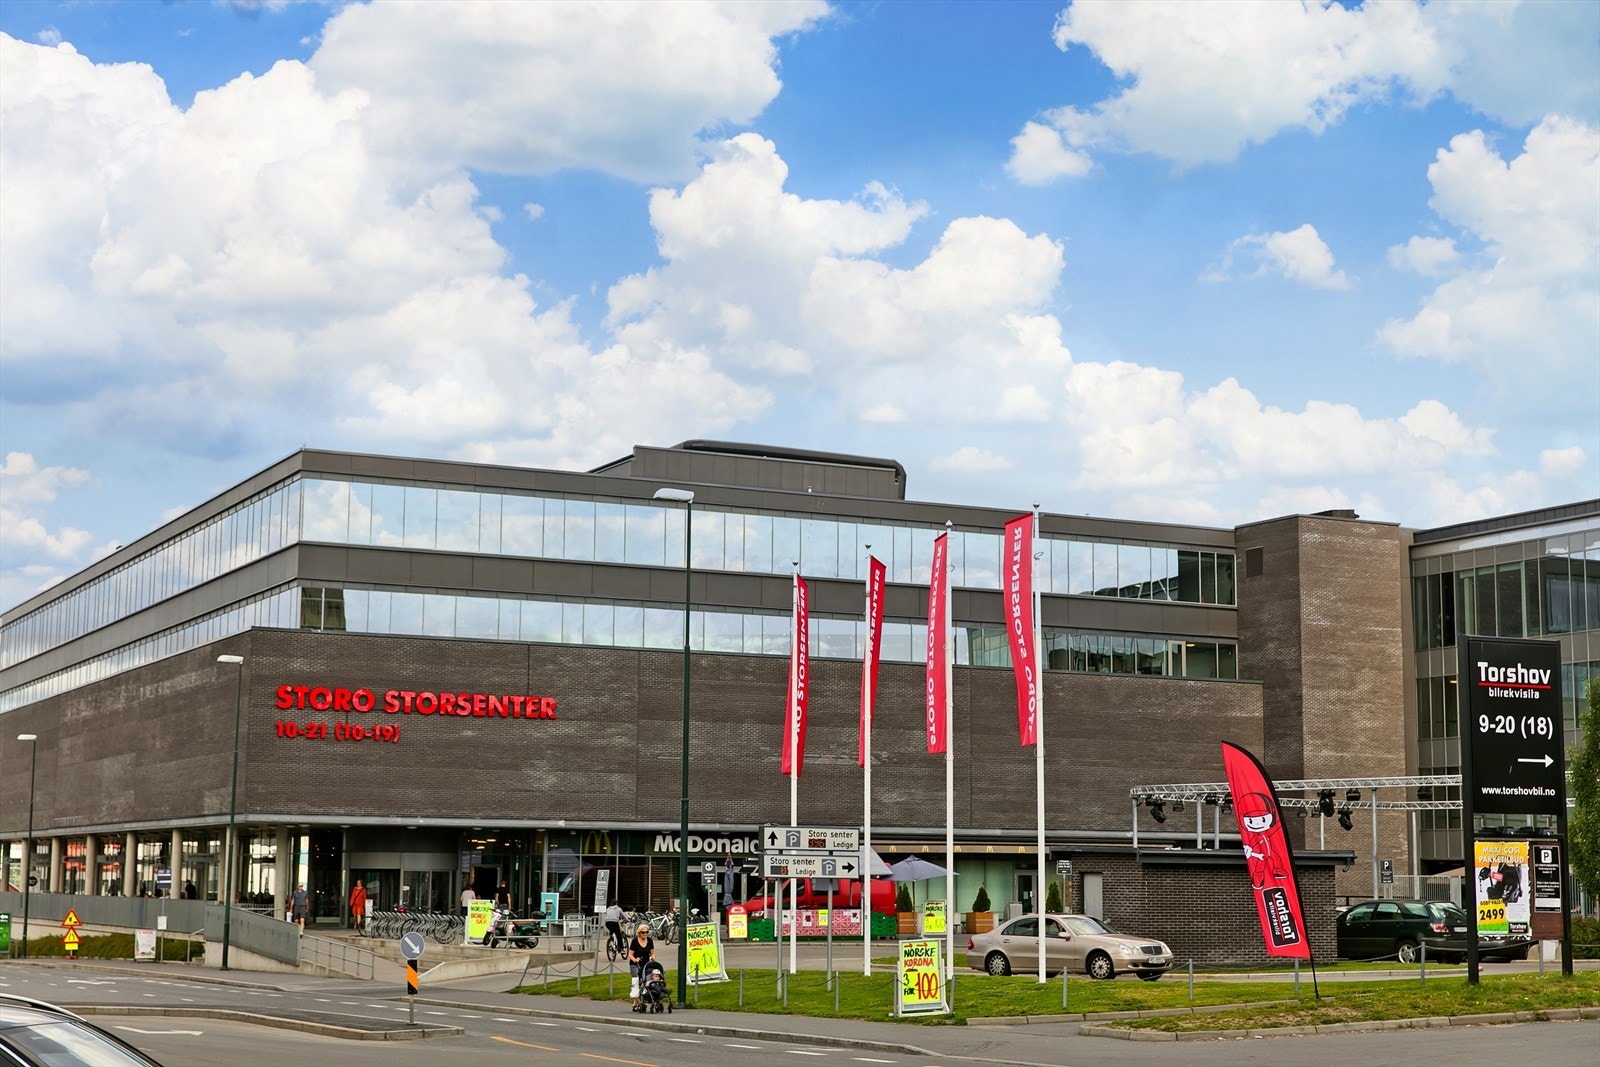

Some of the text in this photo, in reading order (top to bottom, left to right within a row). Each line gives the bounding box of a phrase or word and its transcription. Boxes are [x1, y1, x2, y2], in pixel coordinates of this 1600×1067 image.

[1477, 661, 1551, 685] Torshov
[1488, 687, 1540, 699] bilrekvisita
[275, 684, 557, 720] STORO STORSENTER
[275, 721, 401, 743] 10-21 (10-19)
[1478, 714, 1554, 740] 9-20 (18)
[1481, 786, 1556, 797] www.torshovbil.no
[808, 830, 828, 838] Storo
[833, 841, 854, 849] Ledige
[770, 857, 789, 865] Storo
[795, 868, 817, 876] Ledige
[1479, 908, 1505, 920] 2499
[688, 938, 714, 947] KORONA
[903, 958, 934, 968] KORONA
[903, 973, 910, 986] 3
